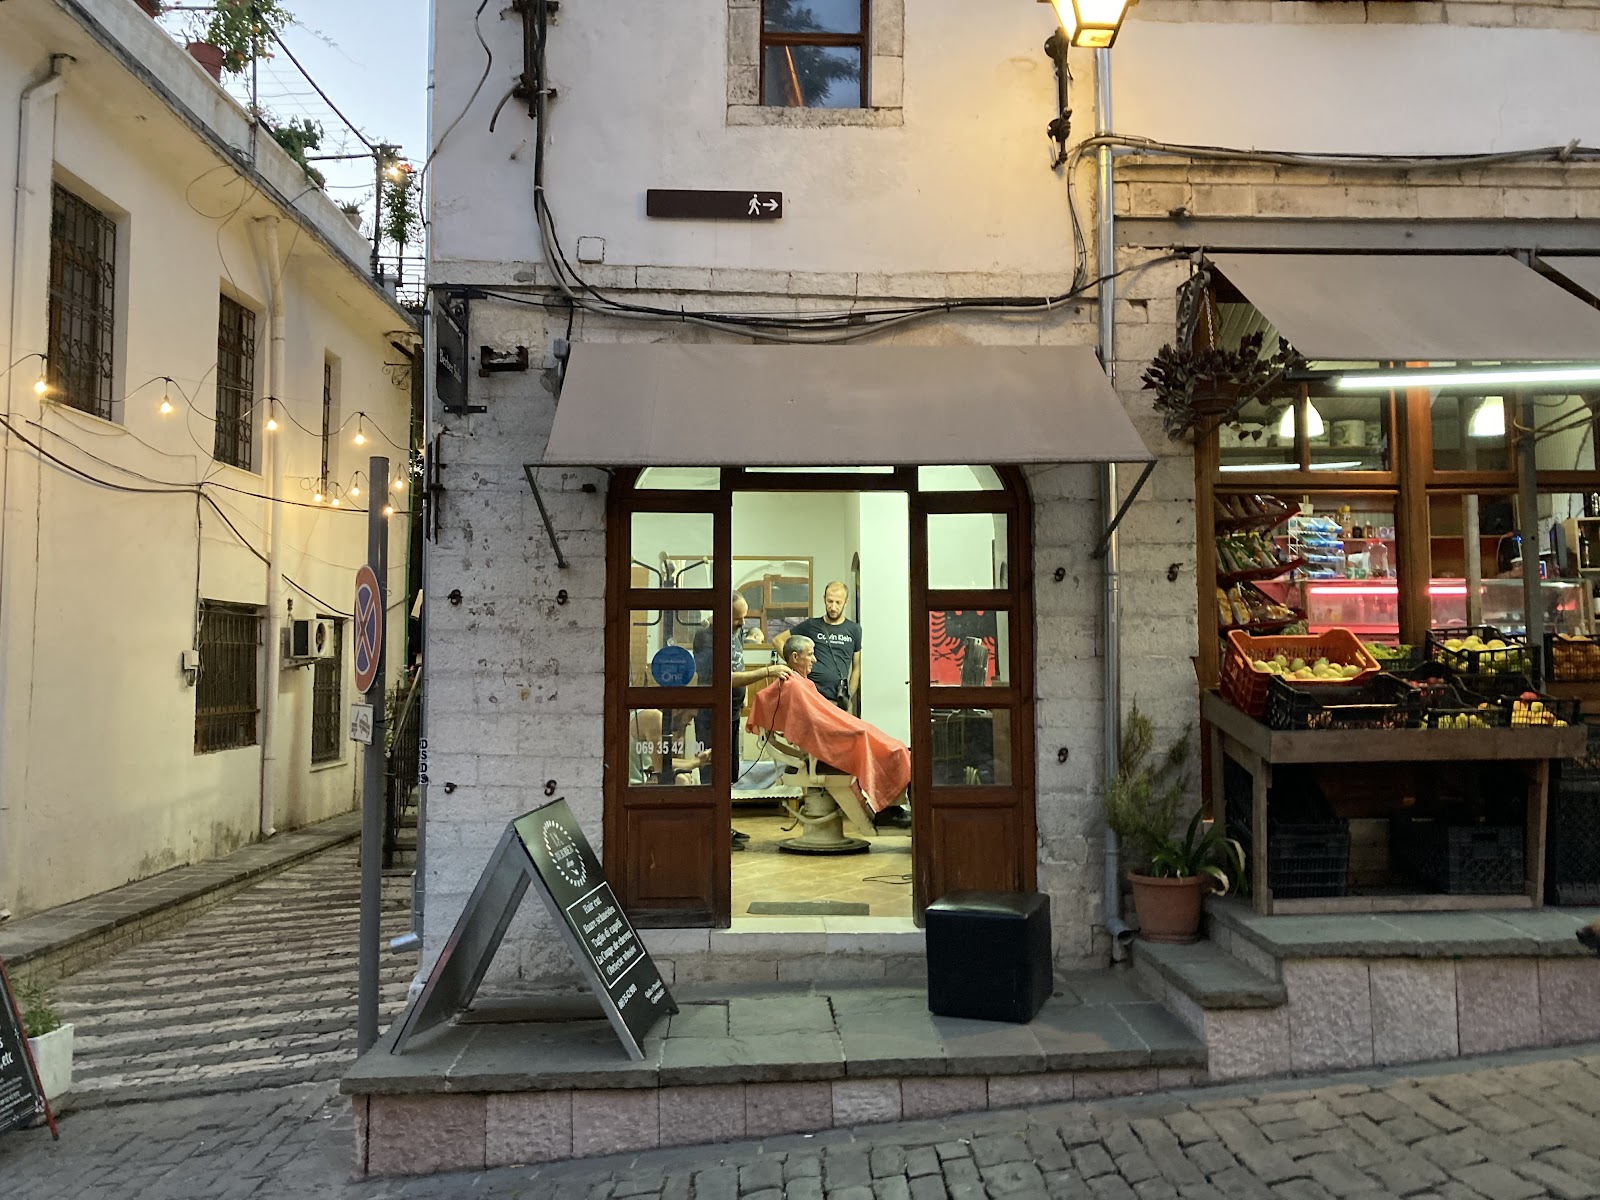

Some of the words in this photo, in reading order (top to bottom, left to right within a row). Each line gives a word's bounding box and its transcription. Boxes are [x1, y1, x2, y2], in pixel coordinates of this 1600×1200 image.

[636, 741, 654, 755] 069
[656, 741, 669, 755] 35
[671, 741, 684, 755] 42
[582, 901, 595, 914] Hair
[593, 896, 602, 907] cut
[604, 927, 611, 937] di
